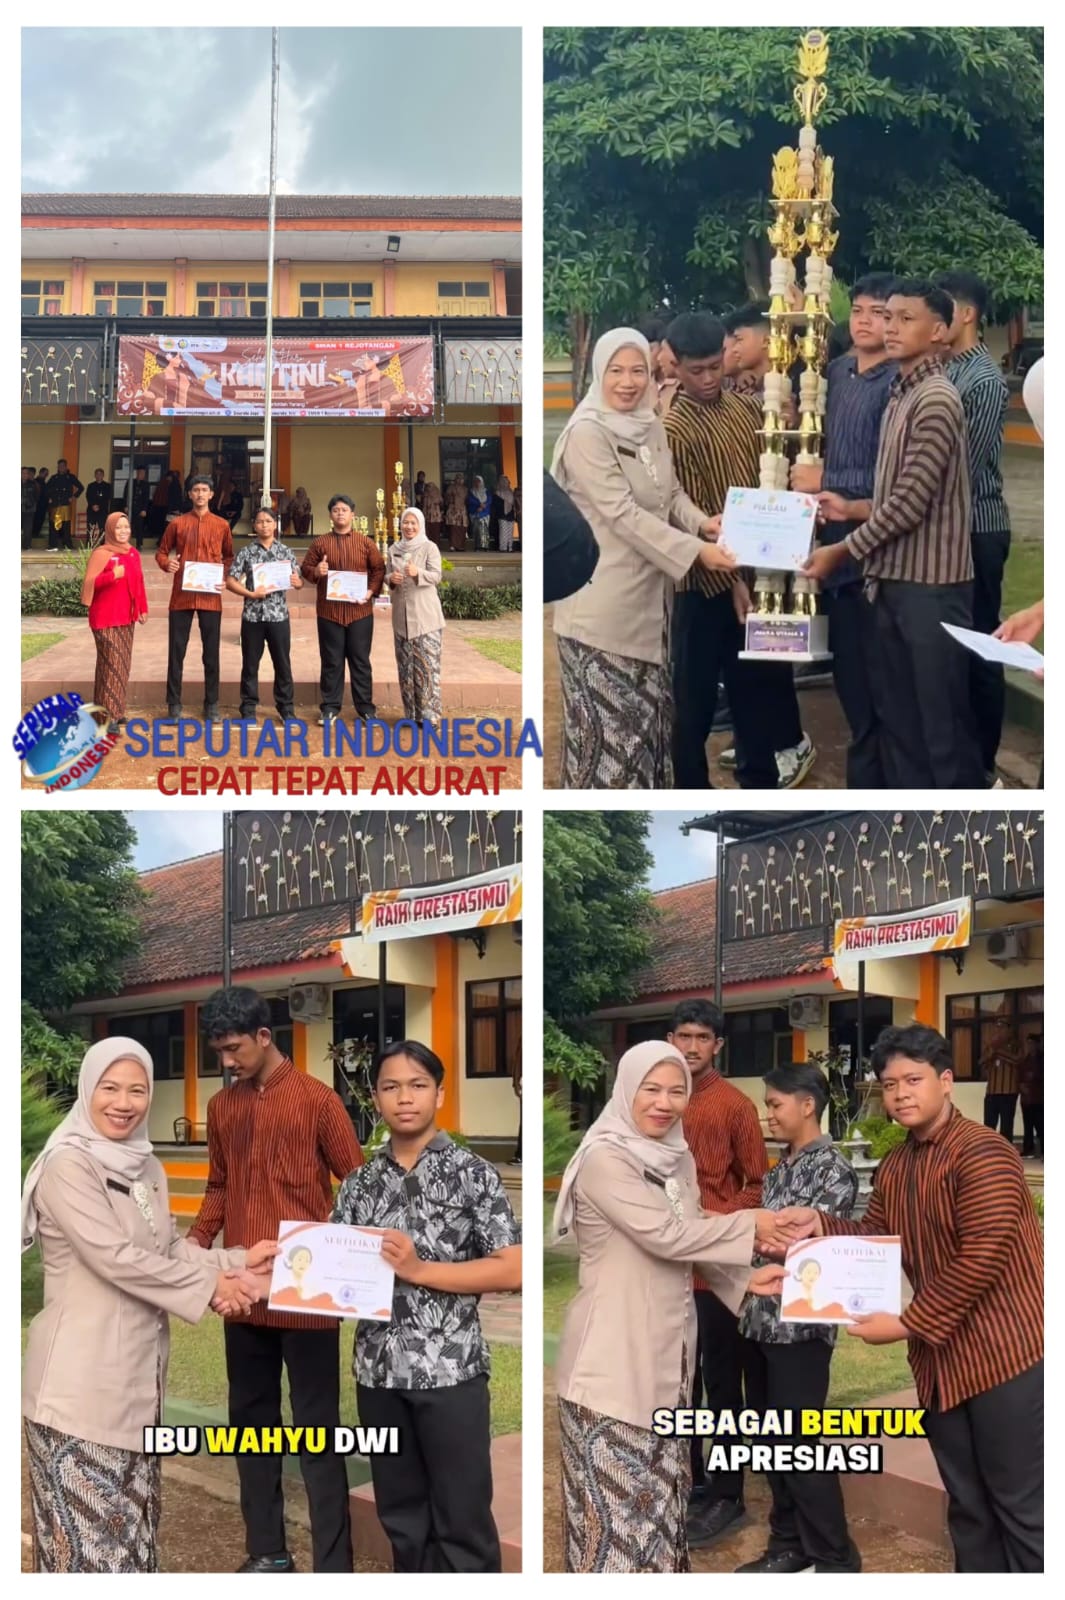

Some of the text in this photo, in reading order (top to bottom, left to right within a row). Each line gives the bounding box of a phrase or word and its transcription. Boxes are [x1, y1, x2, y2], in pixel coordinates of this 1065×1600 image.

[374, 882, 509, 929] RAIH PRESTASIMU
[844, 912, 958, 951] RAIH PRESTASIMU
